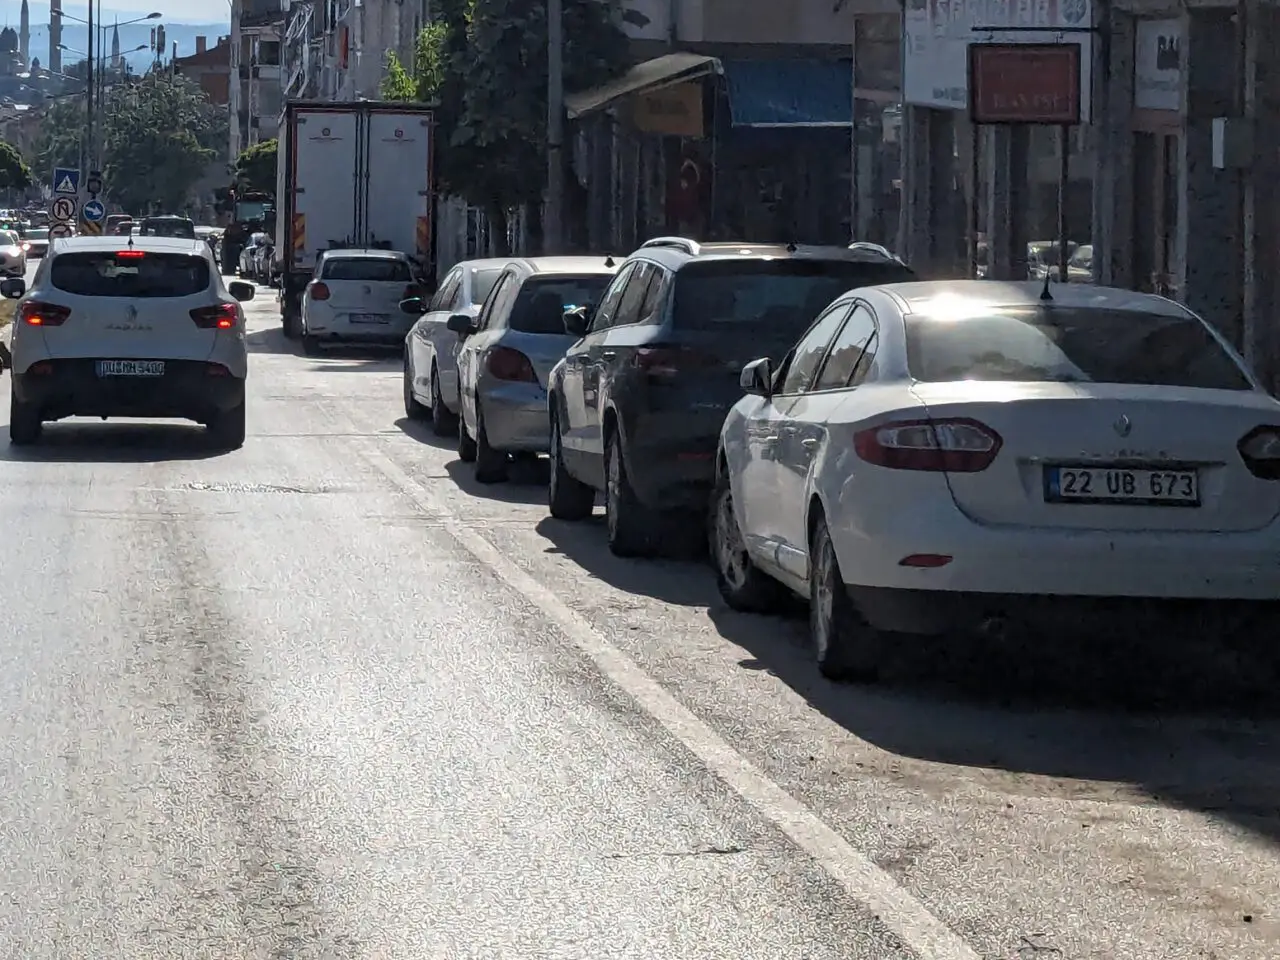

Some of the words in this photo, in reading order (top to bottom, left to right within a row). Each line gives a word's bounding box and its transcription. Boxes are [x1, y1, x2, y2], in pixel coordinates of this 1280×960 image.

[1063, 471, 1093, 494] 22
[1106, 471, 1136, 494] UB
[1150, 472, 1193, 496] 673
